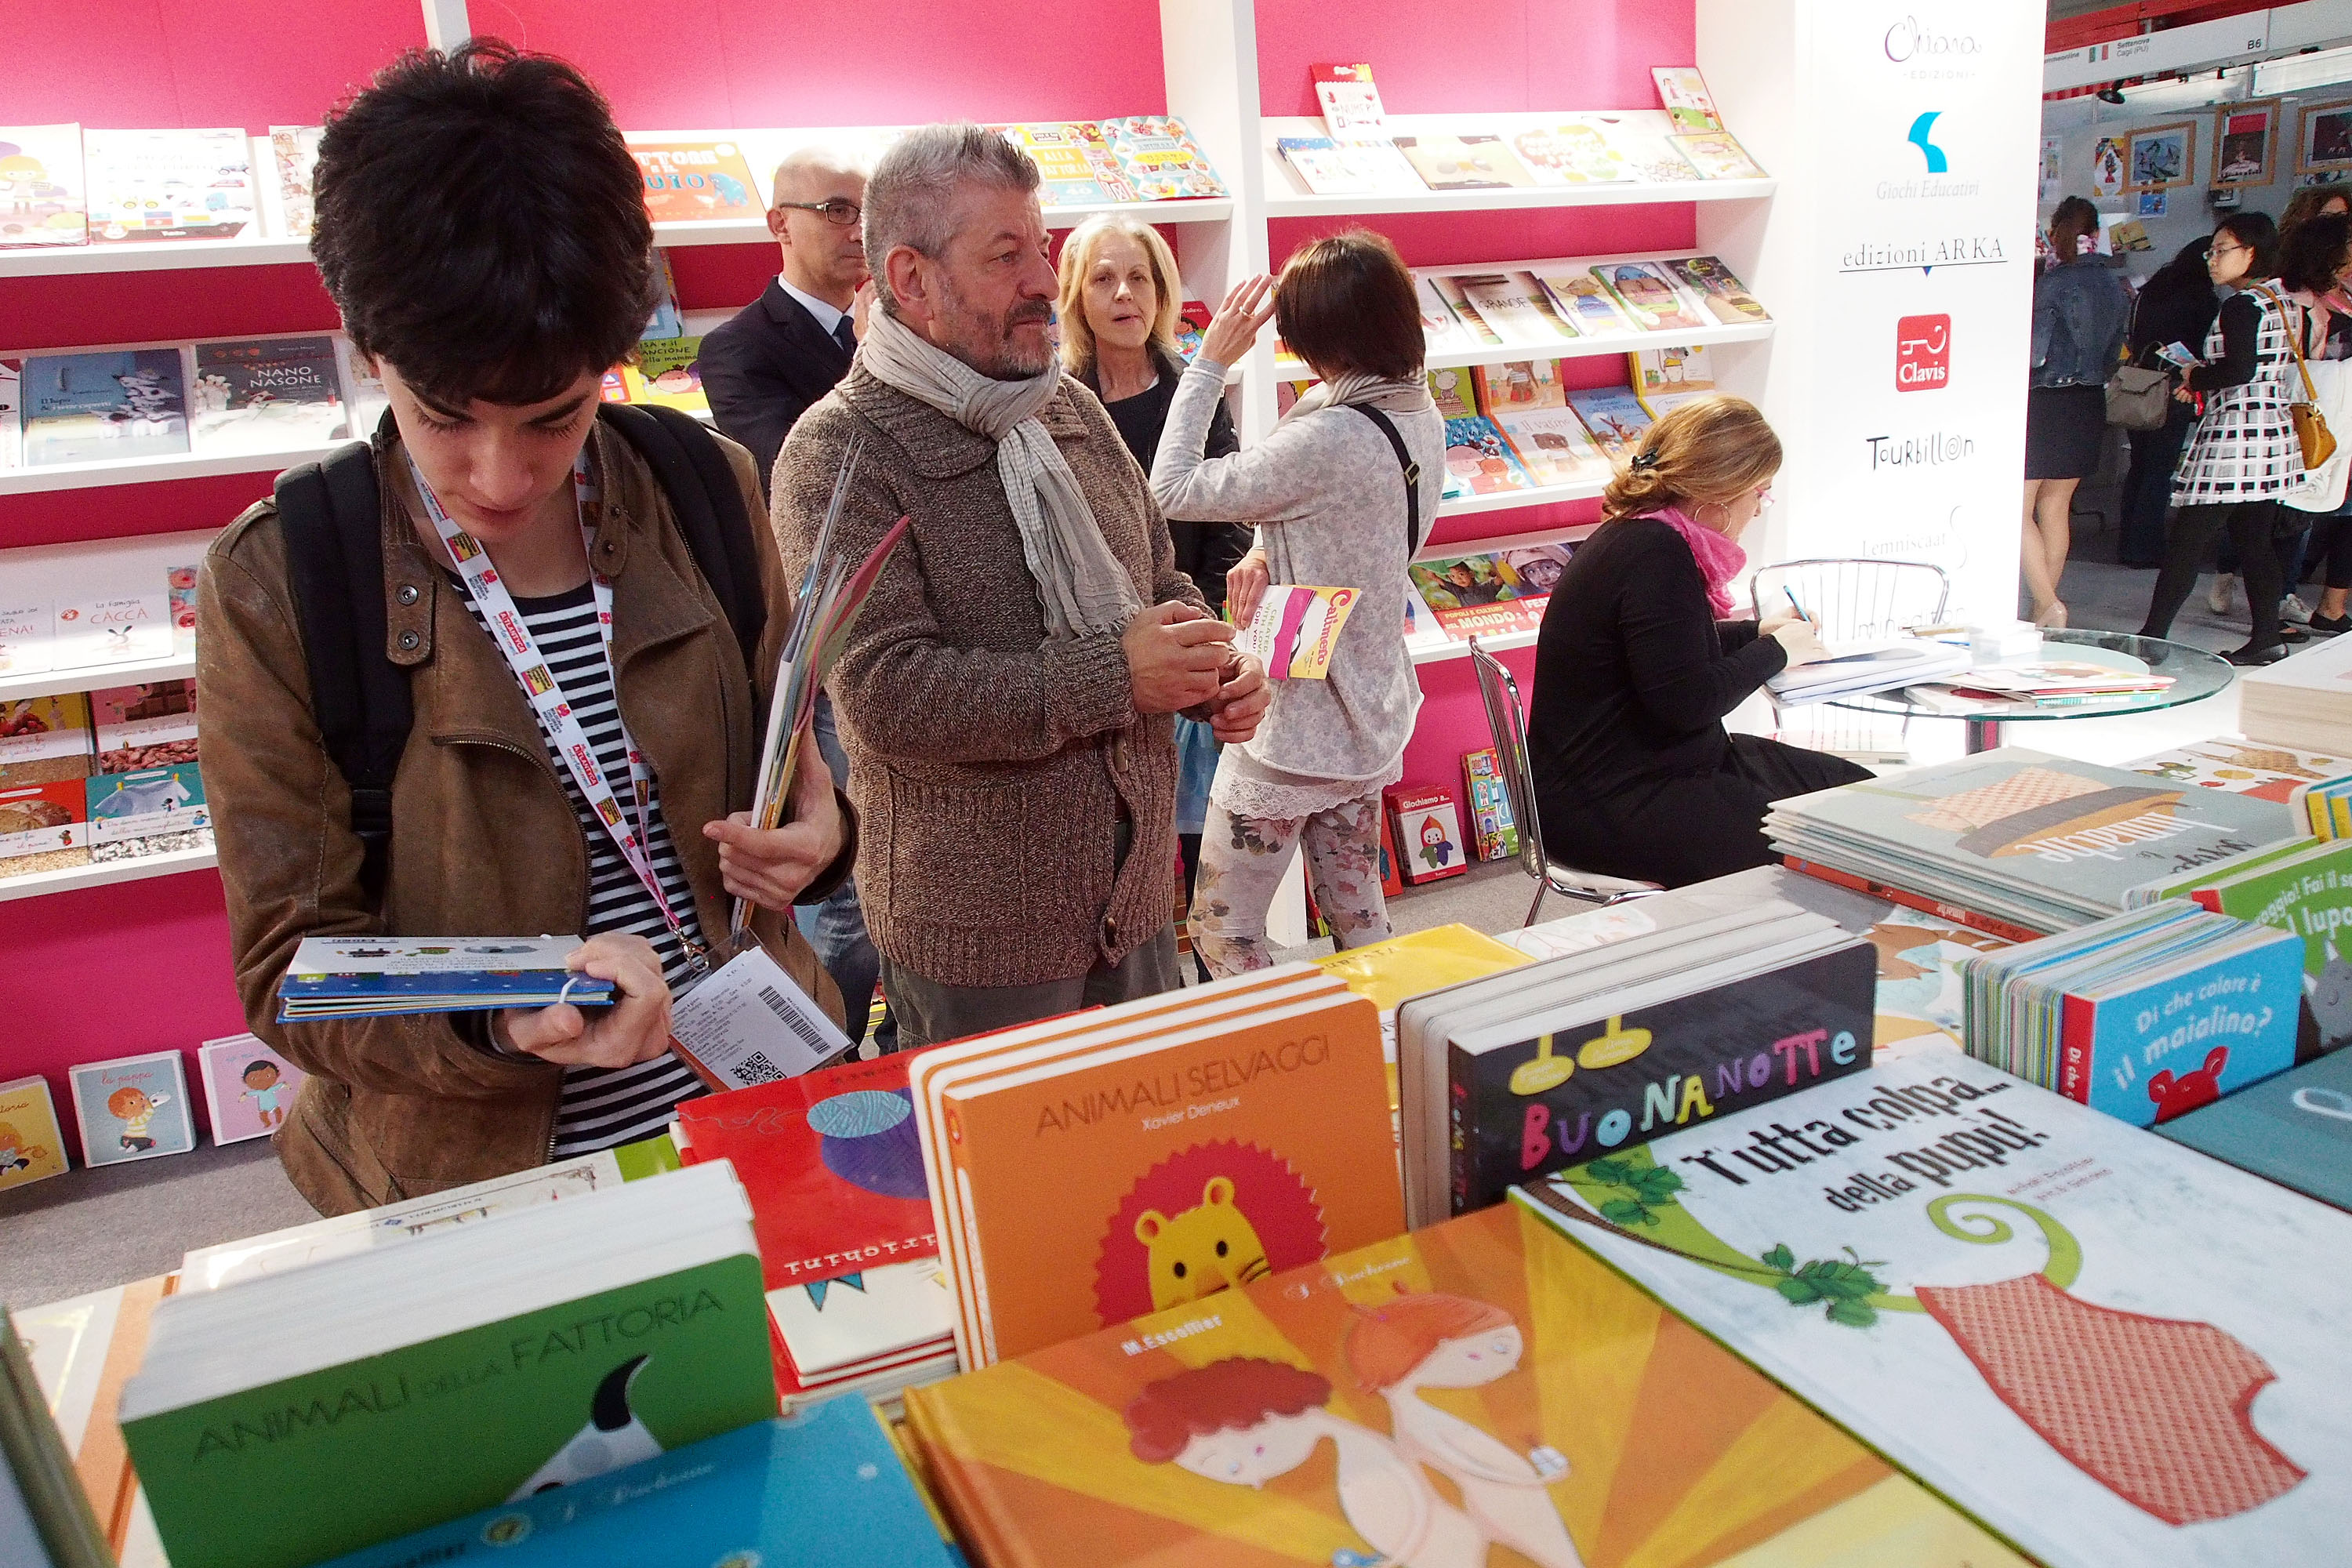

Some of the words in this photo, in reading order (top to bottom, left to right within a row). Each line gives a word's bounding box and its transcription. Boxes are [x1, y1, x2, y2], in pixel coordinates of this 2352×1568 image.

[1884, 14, 1982, 63] Chiara
[2117, 49, 2133, 58] Cagli
[2133, 45, 2149, 56] (PU)
[1910, 70, 1969, 80] EDIZIONI
[633, 151, 719, 166] TTORE
[644, 172, 705, 190] UIO
[1876, 180, 1918, 200] Giochi
[1921, 178, 1980, 198] Educativi
[1843, 241, 1926, 267] edizioni
[1935, 237, 2003, 261] ARKA
[639, 340, 658, 349] ISA
[642, 346, 691, 355] ANCIONE
[250, 373, 321, 389] NASONE
[257, 366, 312, 379] NANO
[1899, 361, 1946, 384] Clavis
[89, 608, 149, 624] CACCA
[1254, 605, 1263, 625] FOR
[1260, 601, 1274, 627] WITH
[1445, 611, 1470, 619] POPOLI
[1475, 605, 1505, 615] CULTURE
[1459, 611, 1516, 630] MONDO
[0, 625, 34, 637] ENA!
[499, 612, 526, 652] ATLANTYCA
[1263, 608, 1277, 653] CREATED
[1316, 589, 1352, 666] Calimero
[572, 745, 599, 785] ATLANTYCA
[1403, 795, 1439, 809] Giochiamo
[2301, 873, 2325, 896] Fai
[2137, 1007, 2160, 1033] Di
[2164, 991, 2193, 1017] che
[2198, 975, 2248, 1001] colore
[2067, 1046, 2082, 1065] Di
[2114, 1054, 2136, 1091] il
[2146, 1005, 2274, 1066] maialino?
[118, 1070, 154, 1087] pappa
[1034, 1073, 1181, 1138] ANIMALI
[1186, 1033, 1331, 1099] SELVAGGI
[2067, 1066, 2078, 1090] che
[1142, 1110, 1185, 1132] Xavier
[1187, 1097, 1241, 1120] Deneux
[1681, 1119, 1862, 1186] Tutta
[1824, 1173, 1920, 1214] della
[1886, 1107, 2051, 1189] pupù!
[784, 1233, 937, 1276] irichini
[192, 1374, 411, 1464] ANIMALI
[510, 1287, 726, 1371] FATTORIA
